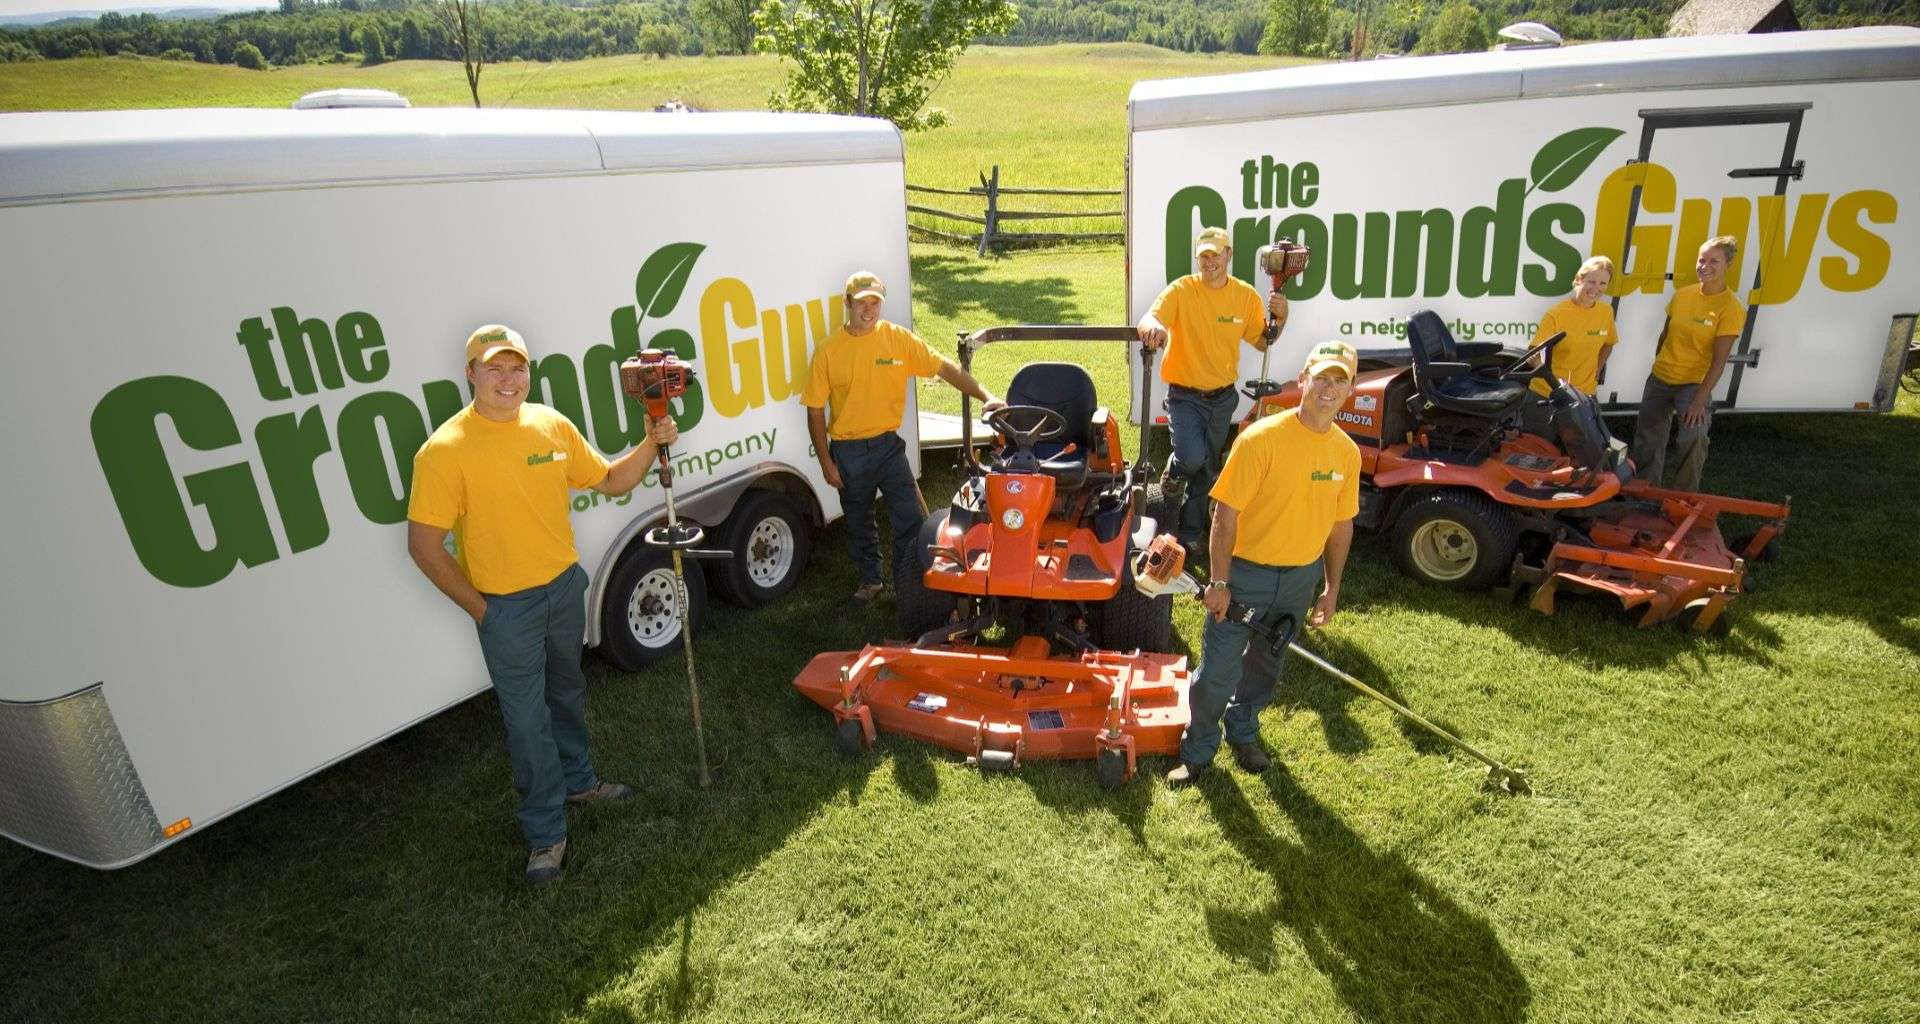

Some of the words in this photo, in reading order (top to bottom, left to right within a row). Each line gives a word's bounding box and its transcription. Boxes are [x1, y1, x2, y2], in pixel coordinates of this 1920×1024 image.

[1241, 155, 1319, 209] the
[1340, 322, 1352, 335] a
[236, 306, 390, 401] the
[1335, 411, 1373, 427] UBOTA
